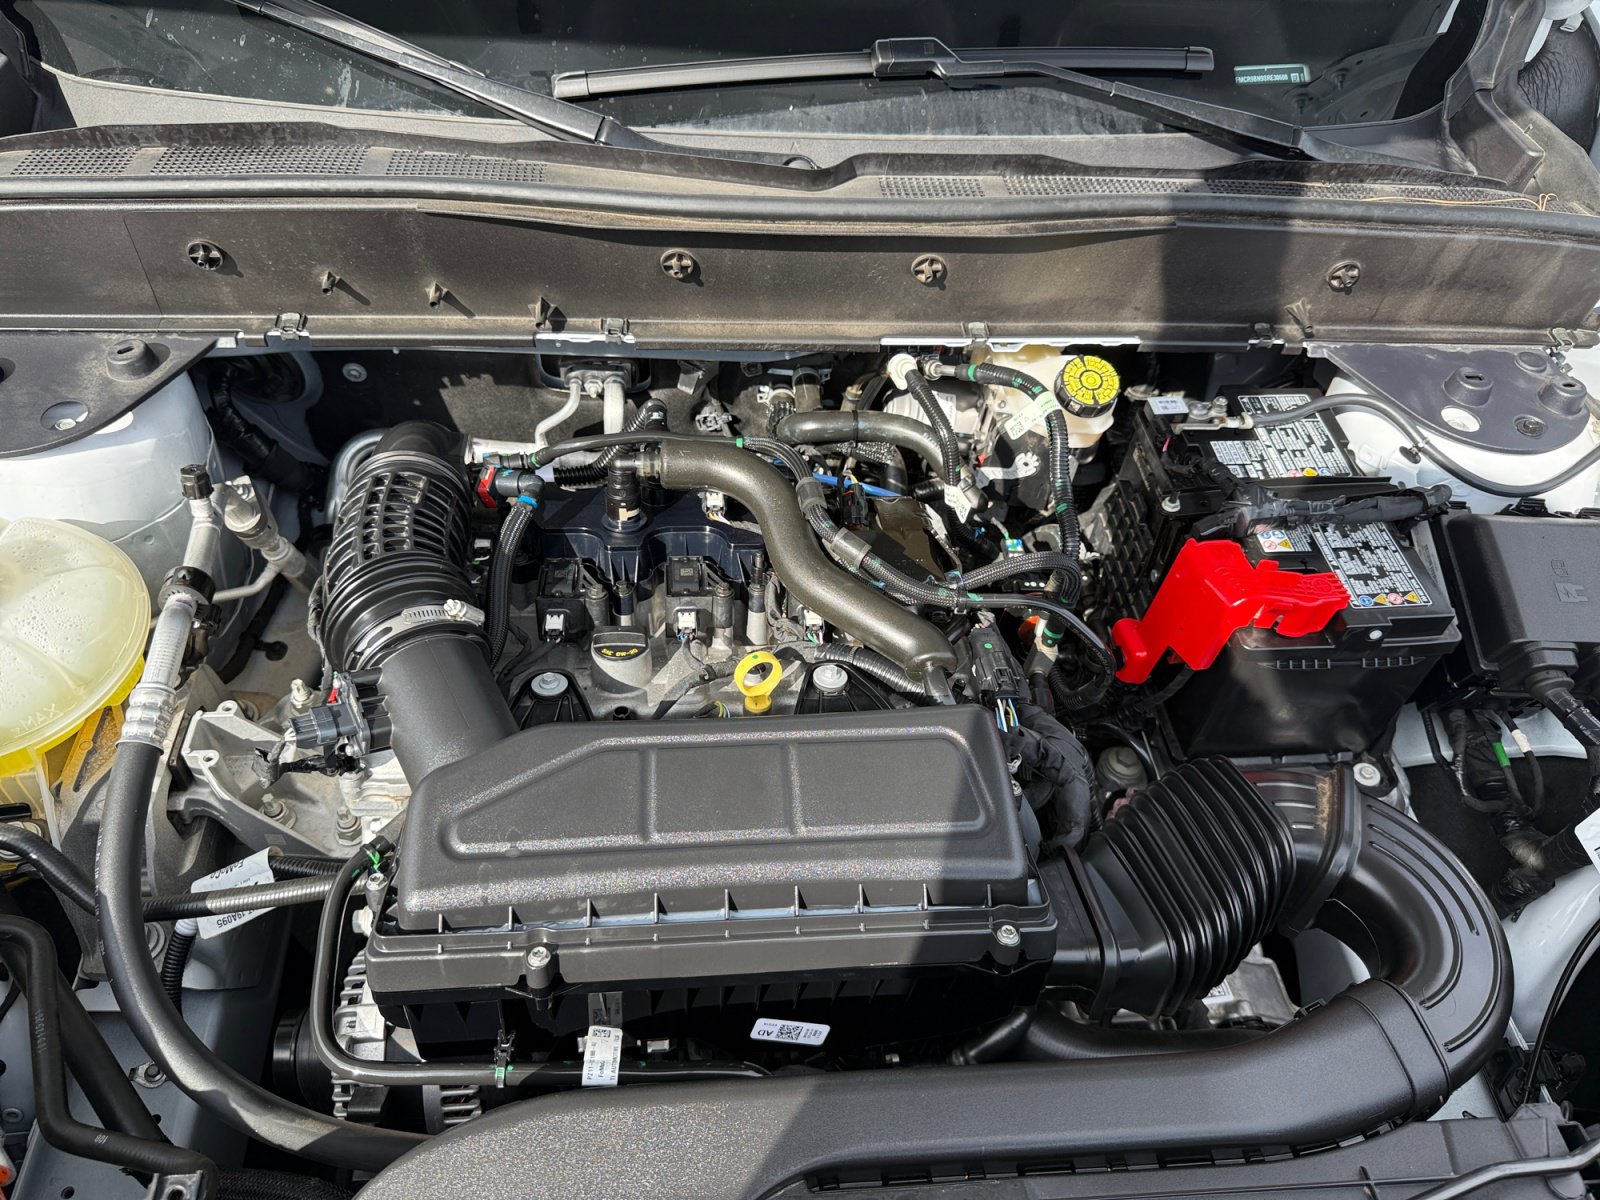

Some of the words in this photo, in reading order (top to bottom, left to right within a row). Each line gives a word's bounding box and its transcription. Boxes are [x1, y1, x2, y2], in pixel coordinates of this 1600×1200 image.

[601, 648, 614, 656] SAE
[615, 648, 638, 657] 0W-20
[19, 703, 64, 731] MAX
[757, 1029, 774, 1037] AD
